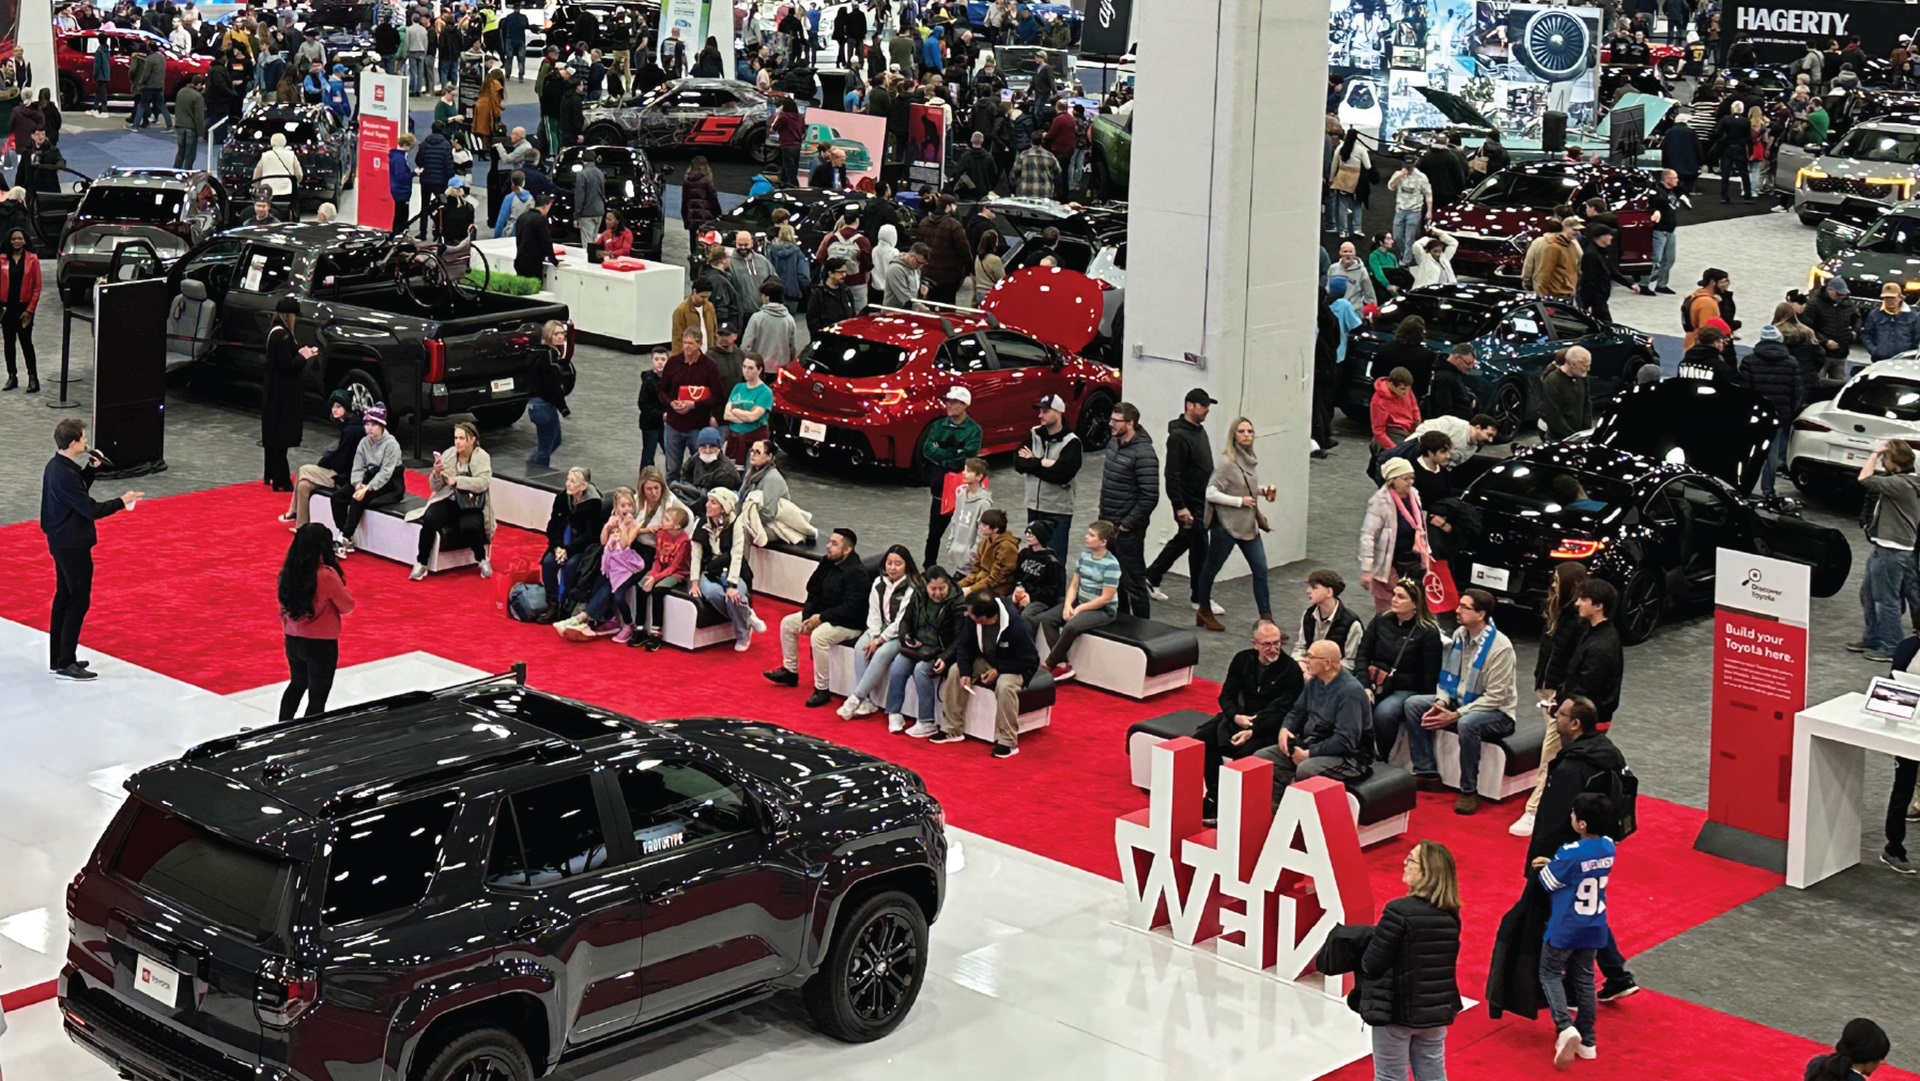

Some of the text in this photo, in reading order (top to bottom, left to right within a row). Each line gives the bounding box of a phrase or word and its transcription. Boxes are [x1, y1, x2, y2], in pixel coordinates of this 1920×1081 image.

[1737, 7, 1849, 36] HAGERTY
[1751, 583, 1783, 597] Discover
[1751, 591, 1776, 602] Toyota
[1726, 623, 1784, 645] Build your
[1726, 638, 1795, 663] Toyota here.
[643, 832, 684, 855] PROTOTYPE
